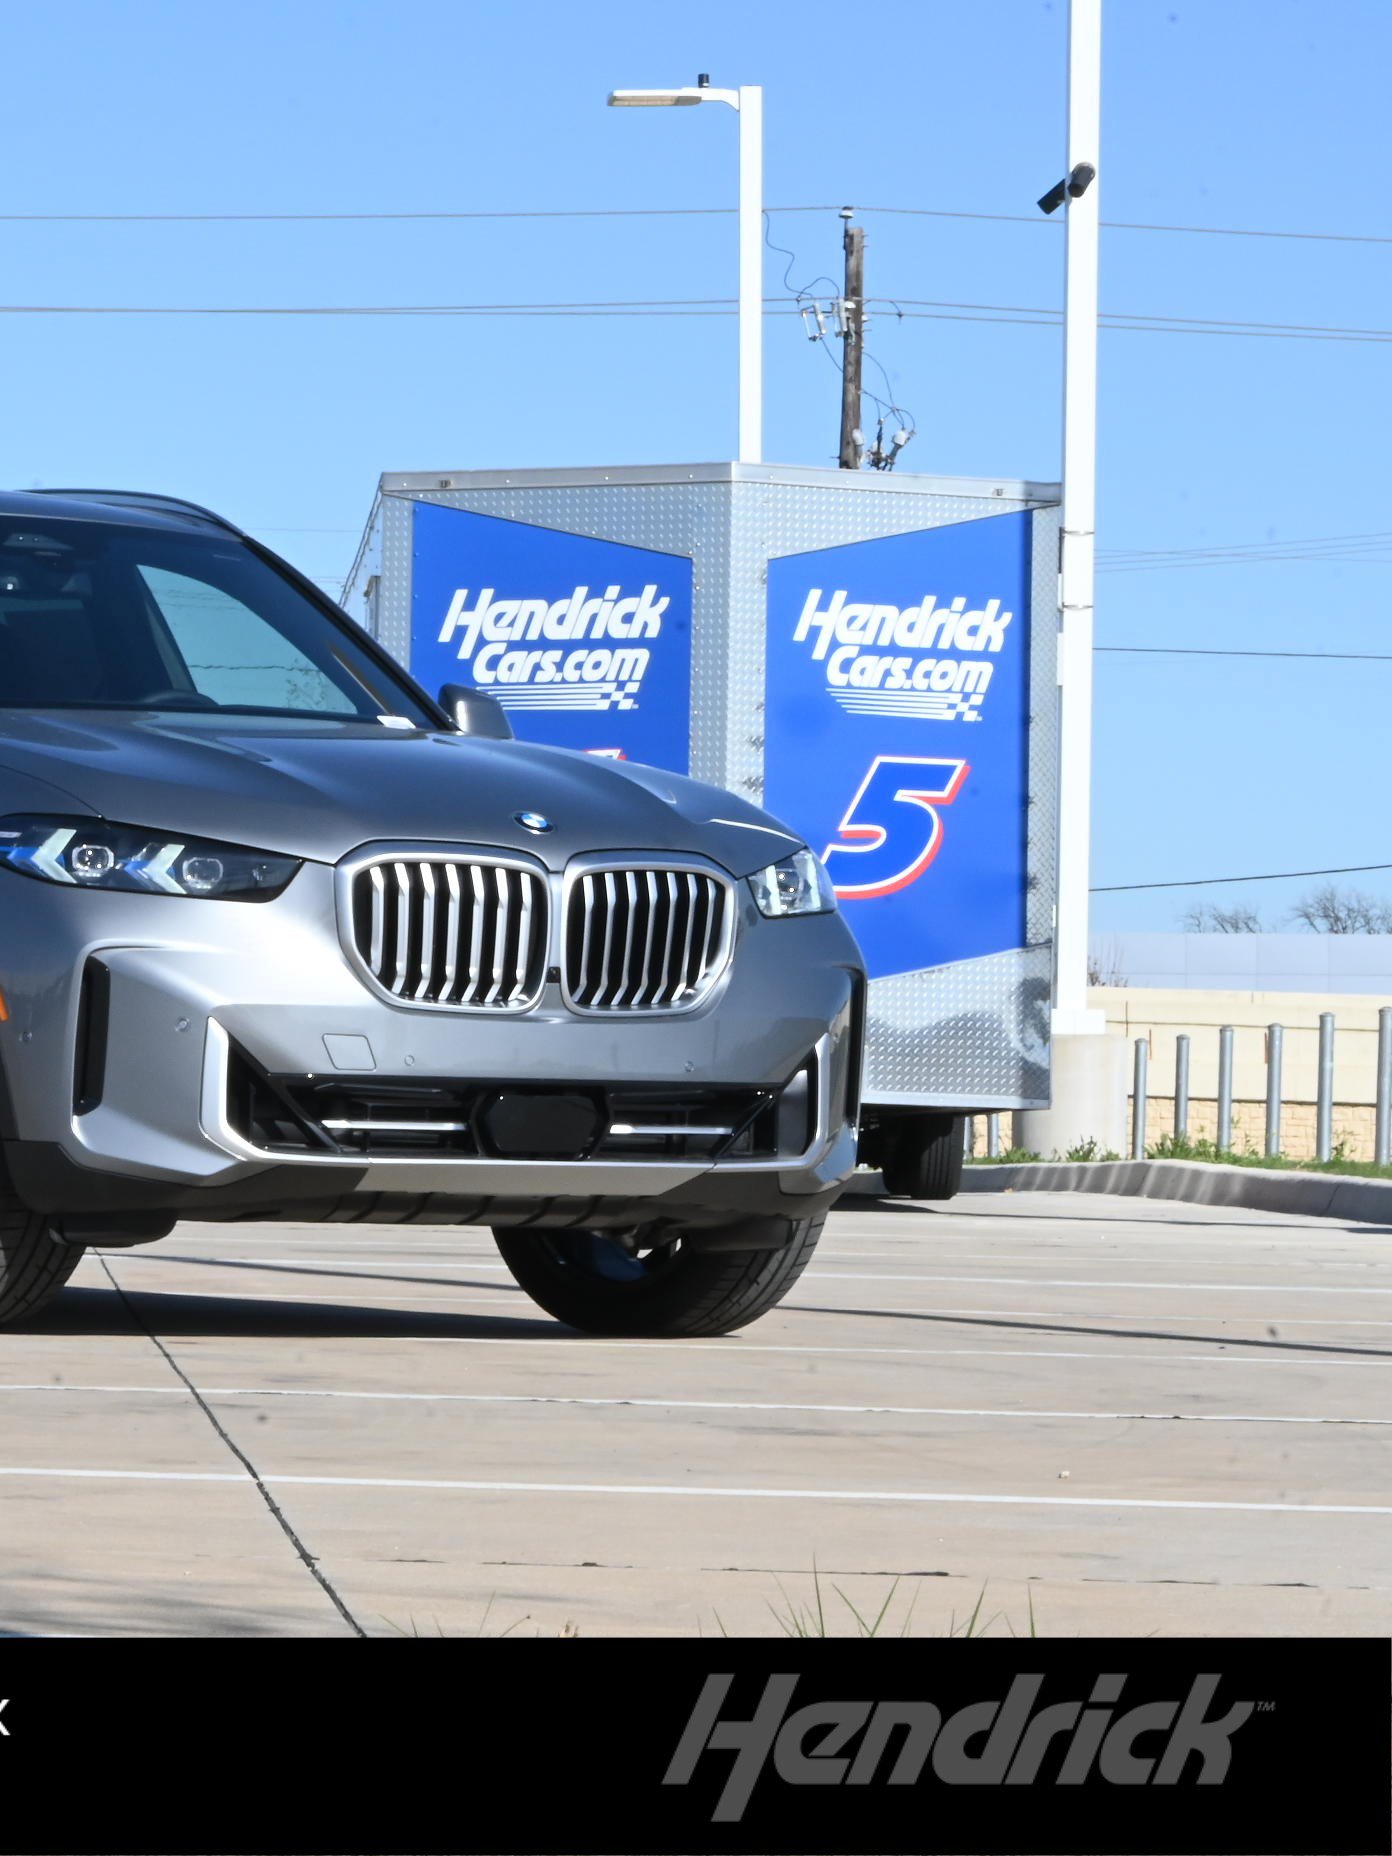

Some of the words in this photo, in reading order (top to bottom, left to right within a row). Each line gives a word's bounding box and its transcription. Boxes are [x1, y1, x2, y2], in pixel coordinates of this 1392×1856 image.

[437, 584, 670, 659] Hendrick
[792, 588, 1012, 660] Hendrick
[472, 642, 650, 683] Cars.com
[826, 645, 994, 693] Cars.com
[820, 755, 971, 899] 5
